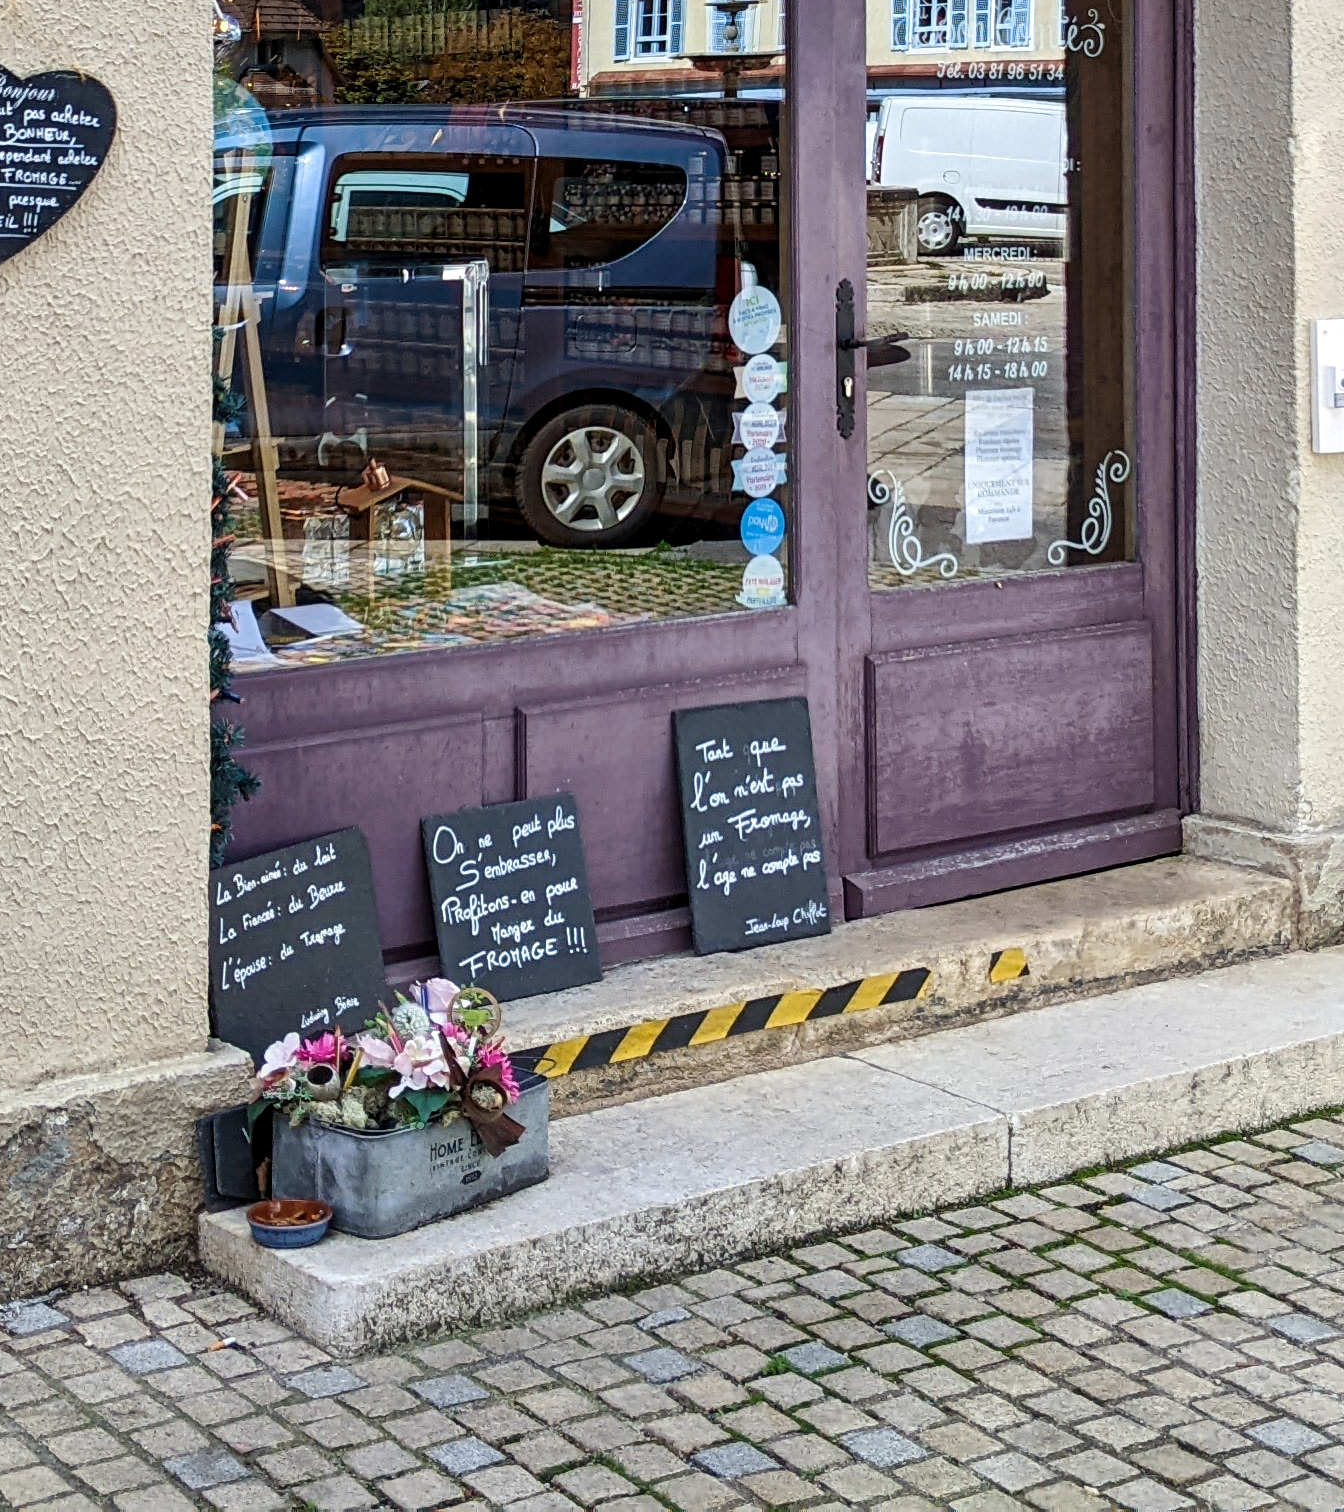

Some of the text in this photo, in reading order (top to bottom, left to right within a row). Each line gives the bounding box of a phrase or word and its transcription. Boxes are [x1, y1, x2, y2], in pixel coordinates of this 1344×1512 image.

[937, 61, 1063, 80] Tél. 03 81 96 51 34
[24, 107, 45, 125] pas
[51, 104, 100, 127] acheter
[58, 150, 98, 165] acheter
[9, 194, 59, 212] presque
[964, 247, 1030, 261] MERCREDI
[973, 312, 1021, 326] SAMEDI
[977, 338, 994, 355] 00
[1006, 337, 1019, 354] 12
[1034, 336, 1048, 353] 15
[948, 363, 961, 381] 14
[977, 363, 991, 380] 15
[1004, 361, 1018, 379] 18
[1031, 360, 1047, 377] 00
[695, 737, 787, 767] Tant que
[690, 767, 804, 812] l'on n'est pas
[433, 805, 574, 864] On ne peut plus
[699, 808, 811, 849] un Fromage,
[741, 864, 757, 878] ne
[762, 849, 799, 875] compte
[802, 849, 821, 870] pas
[217, 882, 232, 905] La
[293, 859, 307, 875] du
[546, 877, 578, 905] pour
[220, 918, 236, 944] La
[289, 895, 303, 913] du
[544, 909, 565, 926] du
[281, 944, 294, 960] du
[459, 938, 558, 978] FROMAGE
[430, 1138, 464, 1162] HOME
